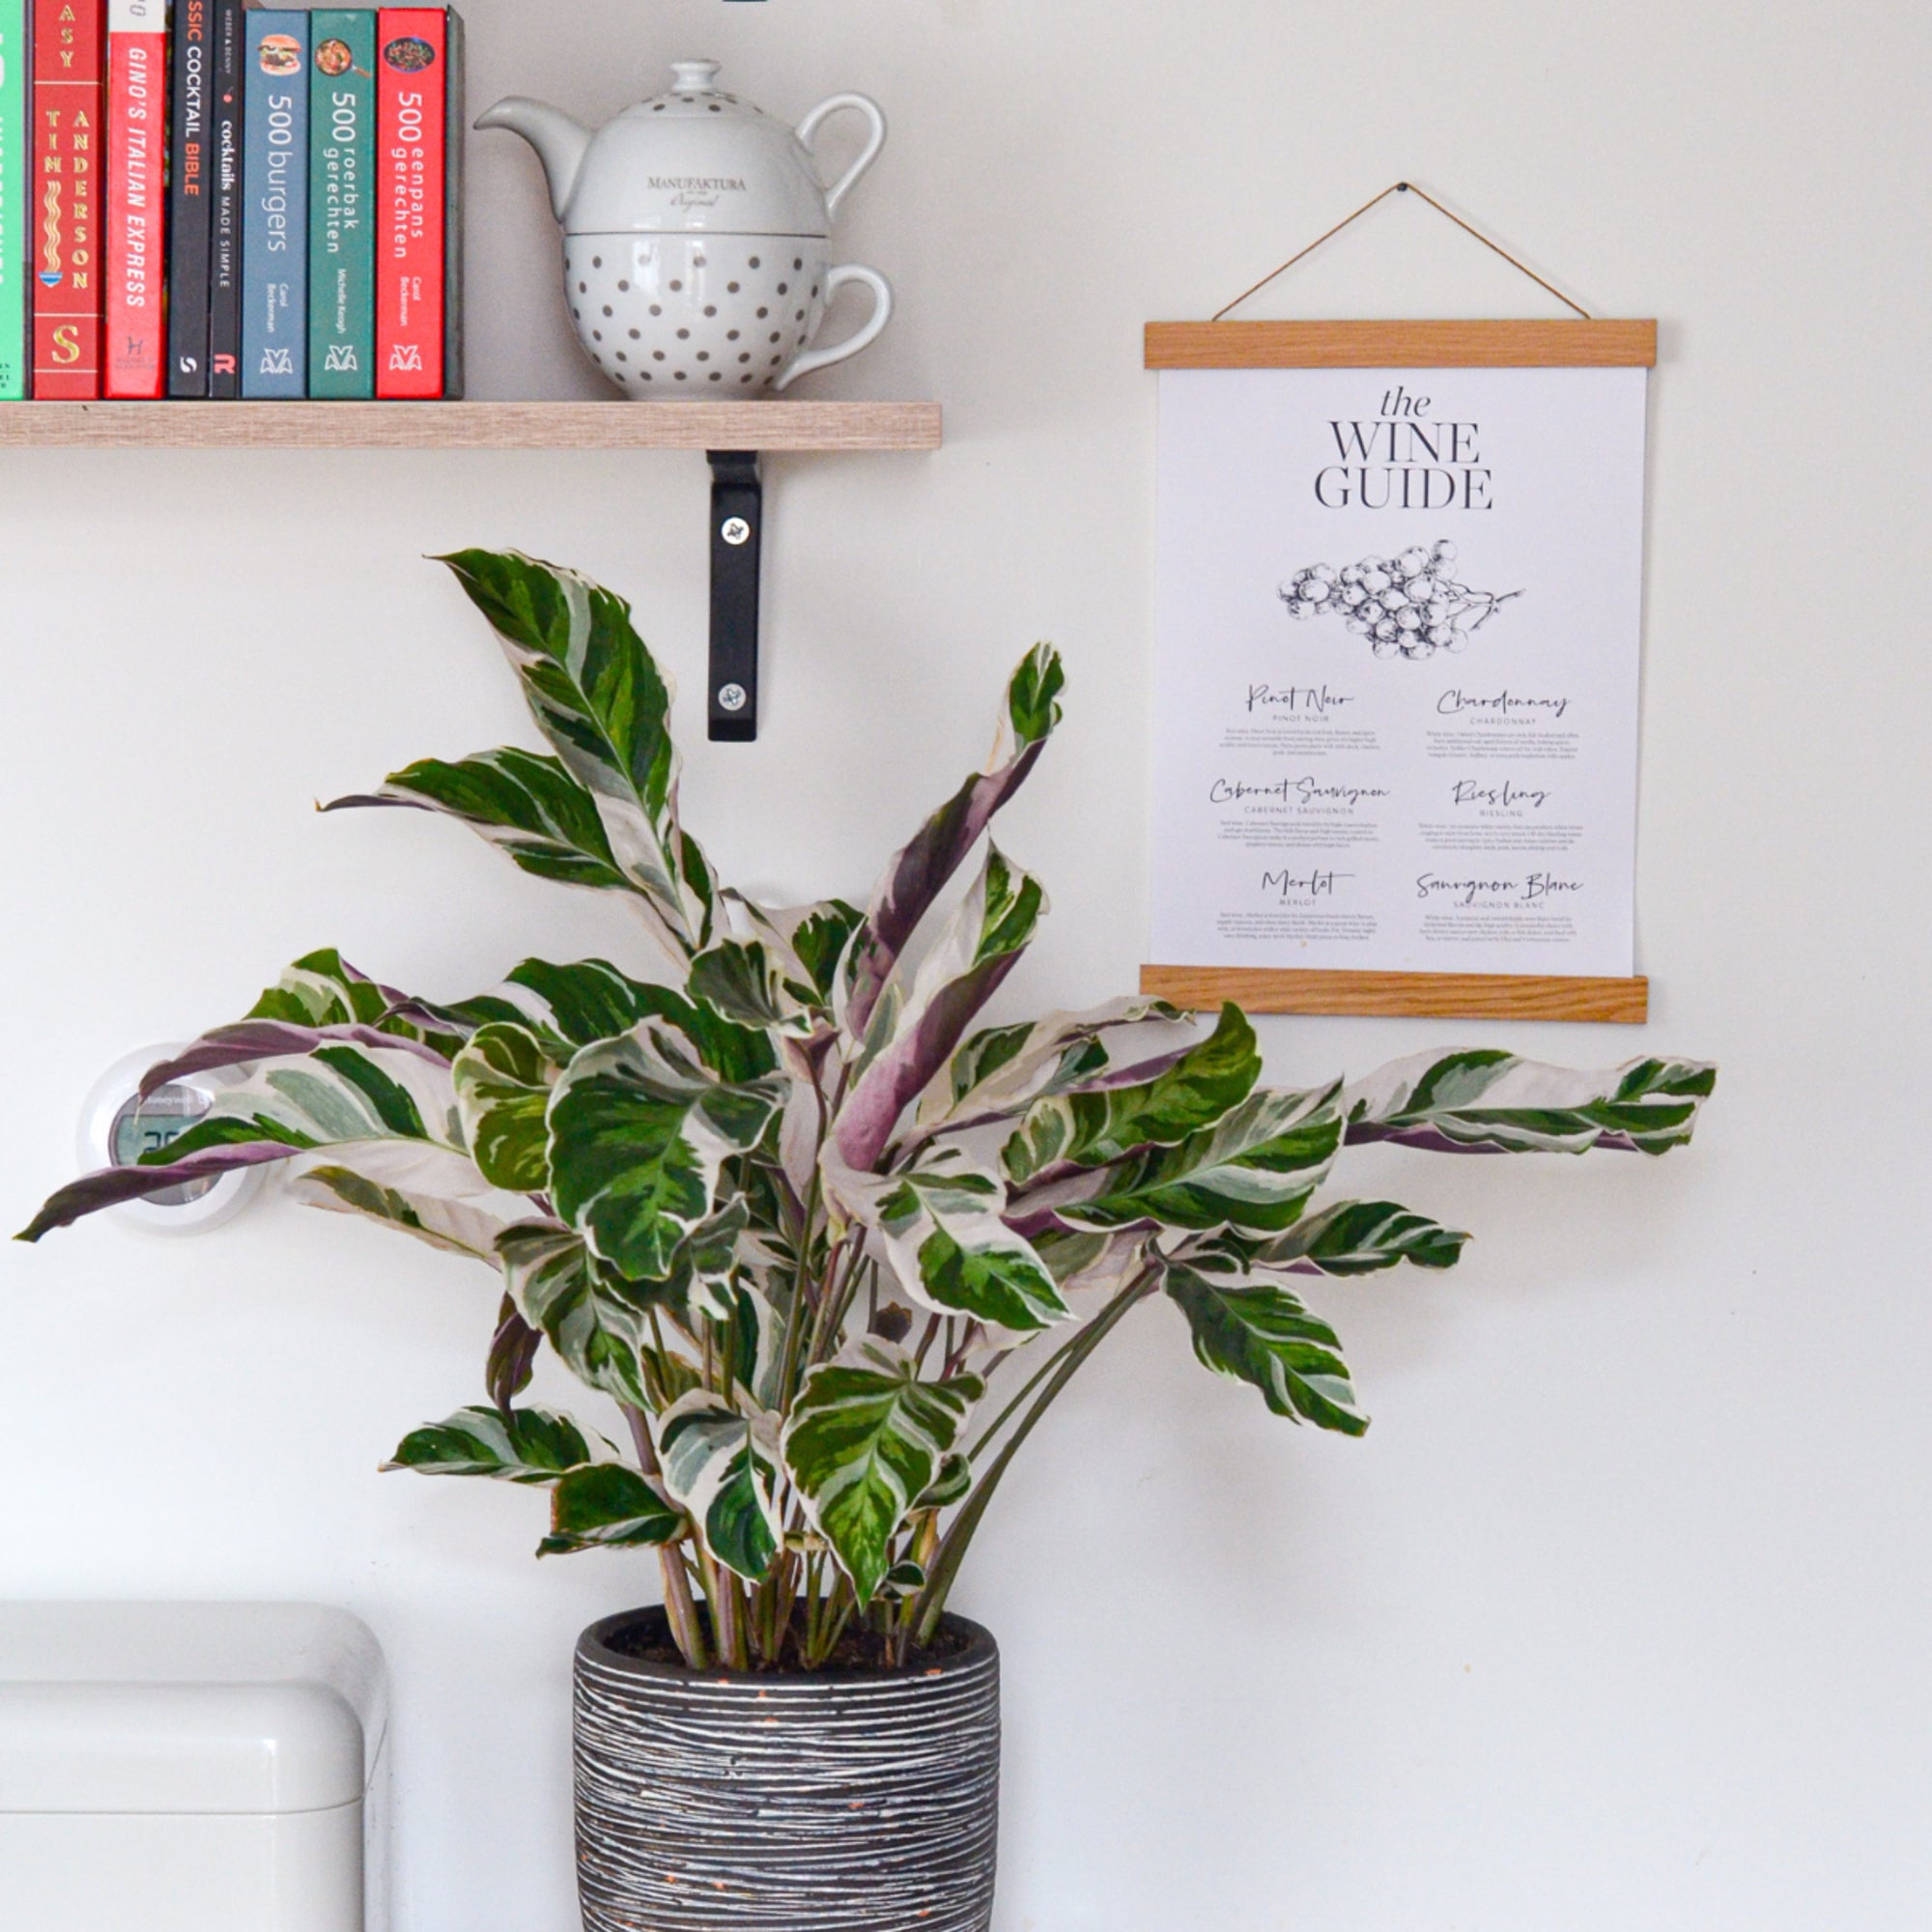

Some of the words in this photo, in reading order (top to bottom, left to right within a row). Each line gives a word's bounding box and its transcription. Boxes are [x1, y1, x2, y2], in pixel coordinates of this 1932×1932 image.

[128, 47, 148, 120] GINO'S
[185, 46, 202, 137] COCKTAIL
[43, 110, 62, 173] TIM
[269, 95, 292, 145] 500
[332, 92, 355, 142] 500
[398, 92, 422, 142] 500
[127, 128, 146, 207] ITALIAN
[184, 143, 199, 196] BIBLE
[220, 120, 234, 190] cocktails
[72, 109, 90, 289] ANDERSON
[262, 151, 293, 251] burgers
[323, 148, 339, 253] gerechten
[343, 149, 359, 228] roerbak
[392, 148, 410, 258] gerechten
[409, 149, 424, 239] eenpans
[220, 196, 231, 235] MADE
[126, 217, 145, 308] EXPRESS
[218, 240, 229, 289] SIMPLE
[1380, 385, 1431, 416] the
[1327, 420, 1479, 463] WINE
[1314, 466, 1492, 509] GUIDE
[1305, 714, 1329, 723] NOIR
[1436, 690, 1571, 717] Chardonnay
[1469, 717, 1537, 725] CHARDONNAY
[1244, 806, 1294, 814] CABERNET
[1297, 806, 1354, 815] SAUVIGNON
[1479, 810, 1523, 818] RIESLING
[1262, 869, 1355, 896] Merlot
[1279, 898, 1317, 907] MERLOT
